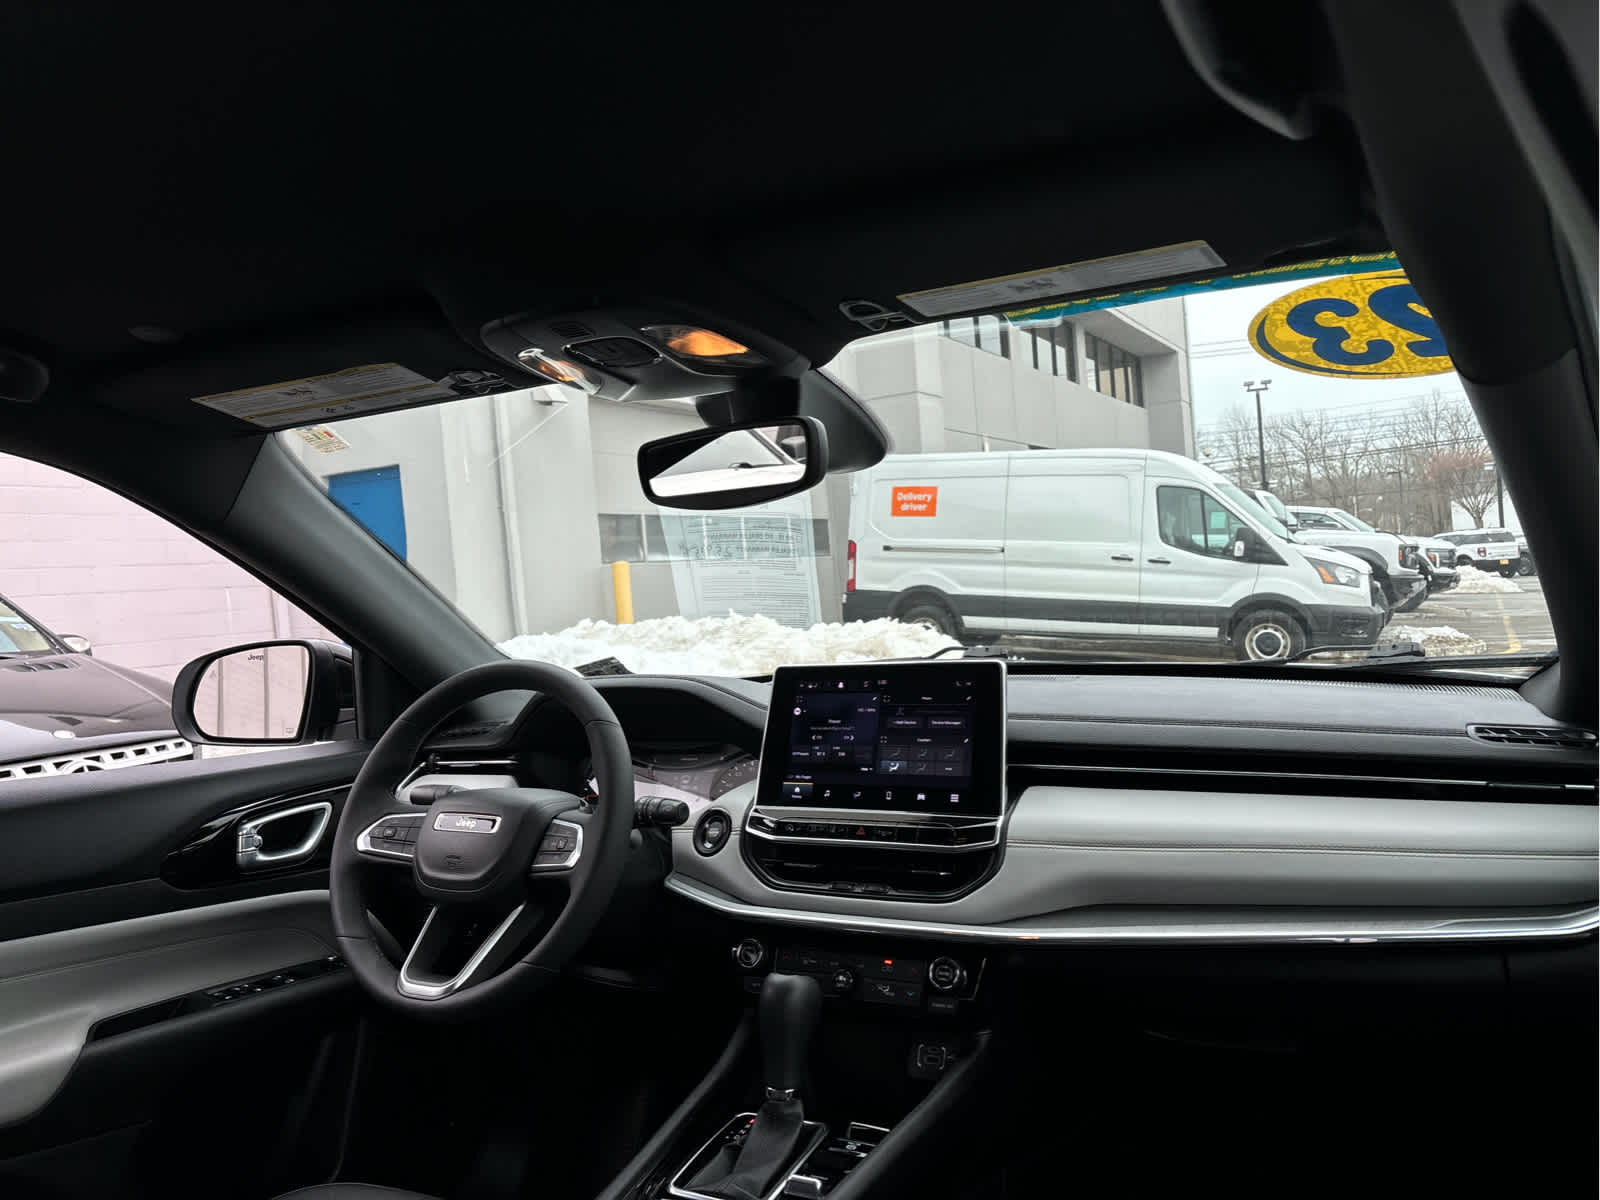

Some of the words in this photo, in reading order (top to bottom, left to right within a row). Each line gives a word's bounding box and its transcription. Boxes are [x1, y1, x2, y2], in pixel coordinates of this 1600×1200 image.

[897, 492, 932, 503] Delivery
[900, 502, 927, 512] driver
[247, 654, 264, 662] Jeep
[455, 816, 477, 829] Jeep
